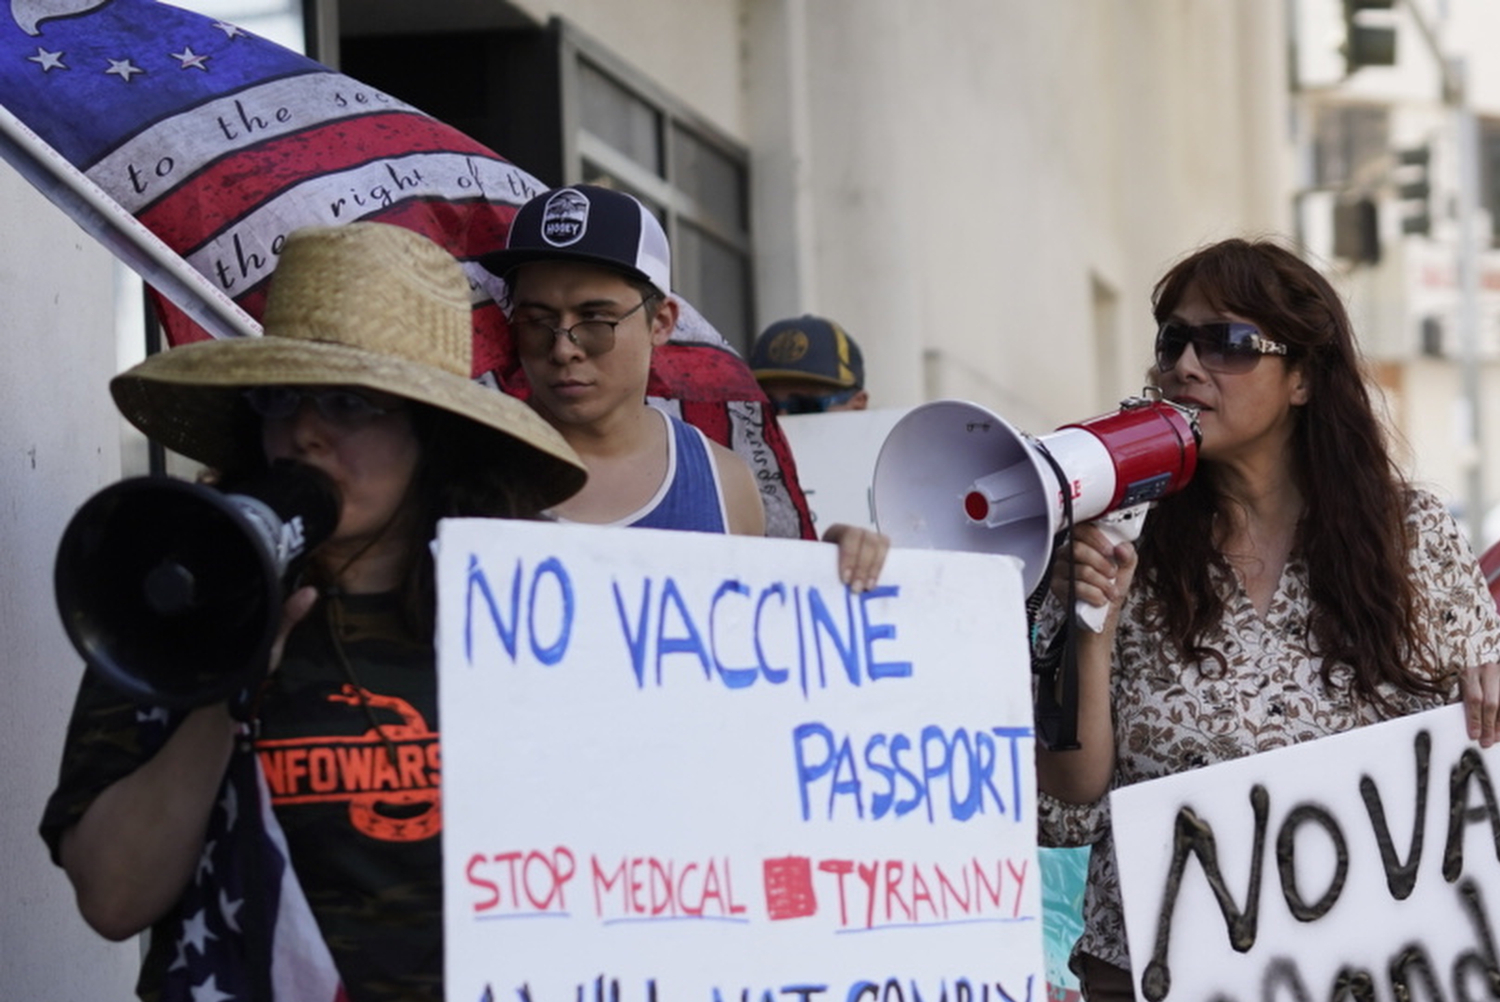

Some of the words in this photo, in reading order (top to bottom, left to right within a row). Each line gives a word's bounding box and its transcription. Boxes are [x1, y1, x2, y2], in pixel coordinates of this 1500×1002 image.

[126, 156, 175, 195] to
[217, 99, 293, 141] the
[330, 162, 426, 219] right
[457, 156, 487, 196] of
[464, 553, 577, 667] NO
[612, 576, 915, 701] VACCINE
[258, 743, 441, 795] NFOWARS
[792, 721, 1035, 824] PASSPORT
[464, 845, 577, 913] STOP
[818, 857, 1030, 929] TYRANNY
